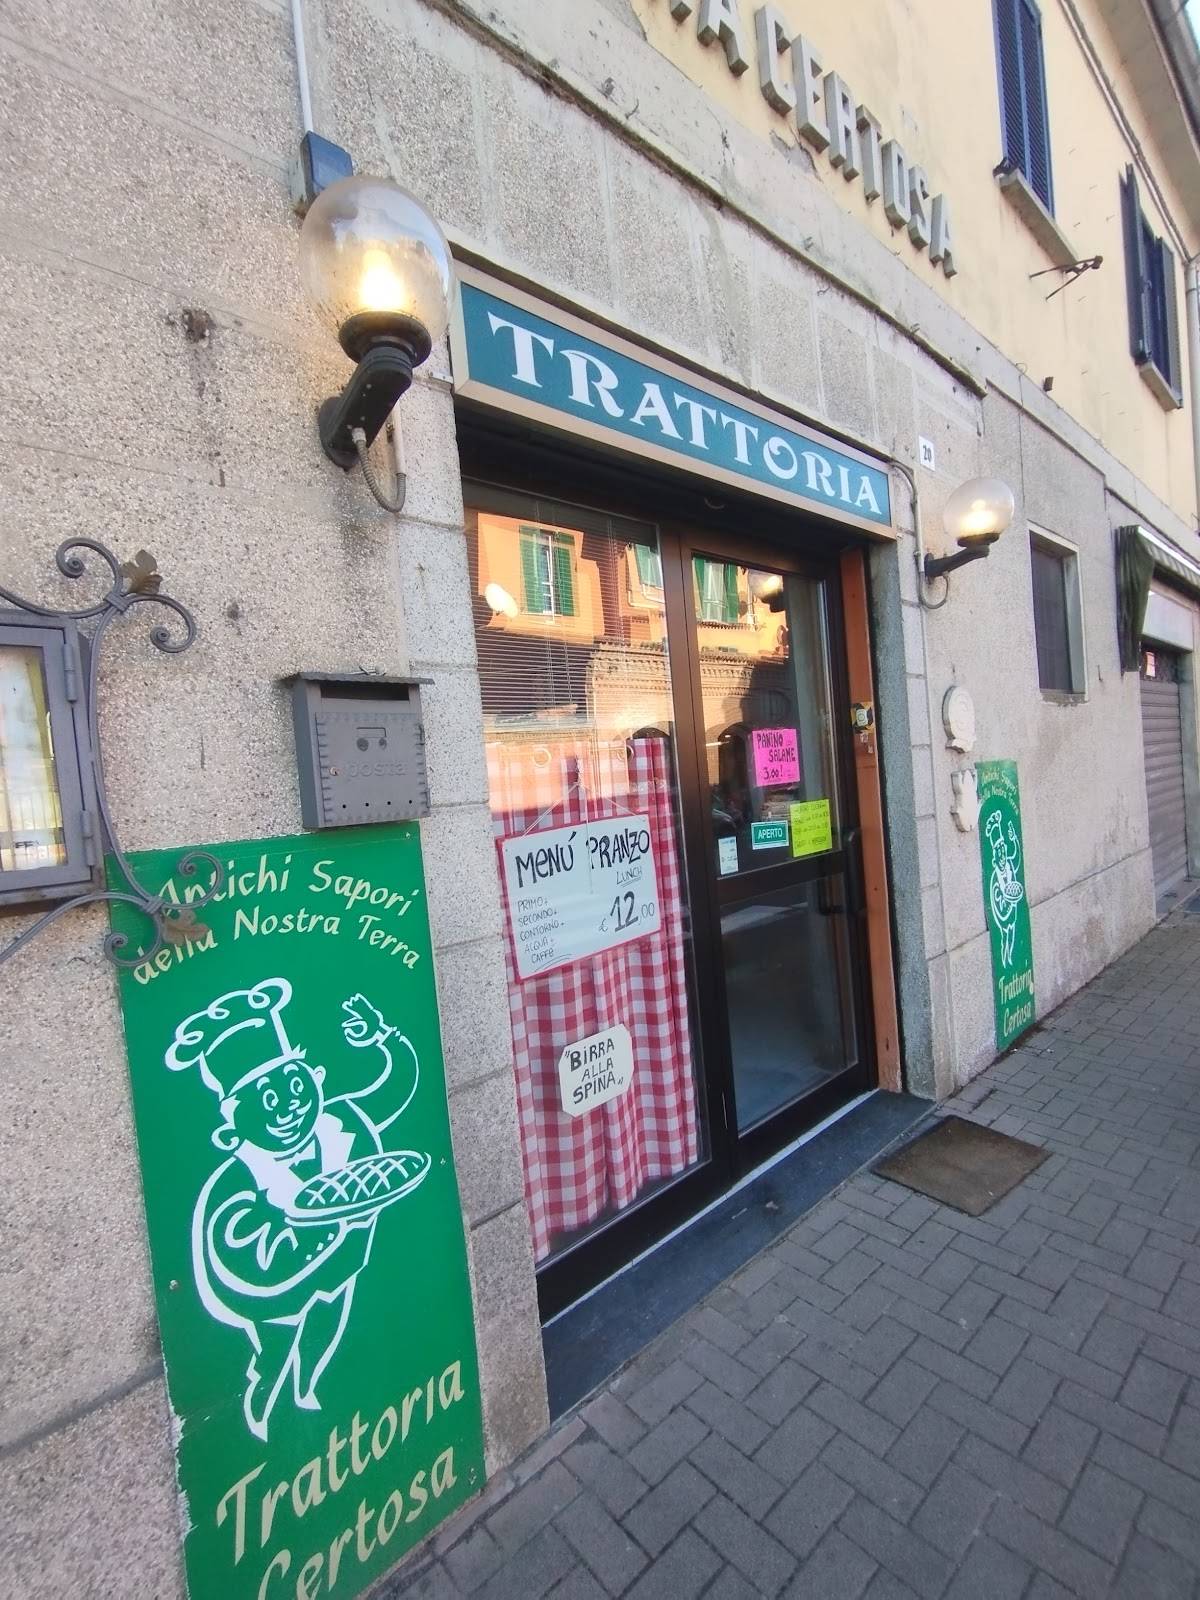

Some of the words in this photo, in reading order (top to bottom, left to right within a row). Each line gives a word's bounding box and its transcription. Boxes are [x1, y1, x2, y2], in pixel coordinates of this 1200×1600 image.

[487, 312, 883, 515] TRATTORIA
[768, 747, 796, 763] SALAME
[757, 828, 783, 840] APERTO
[308, 860, 419, 916] Sapori
[233, 905, 341, 941] Nostra
[358, 914, 420, 969] Terra
[581, 1057, 614, 1082] ALLA
[216, 1360, 465, 1566] Trattoria
[257, 1446, 458, 1600] Certosa
